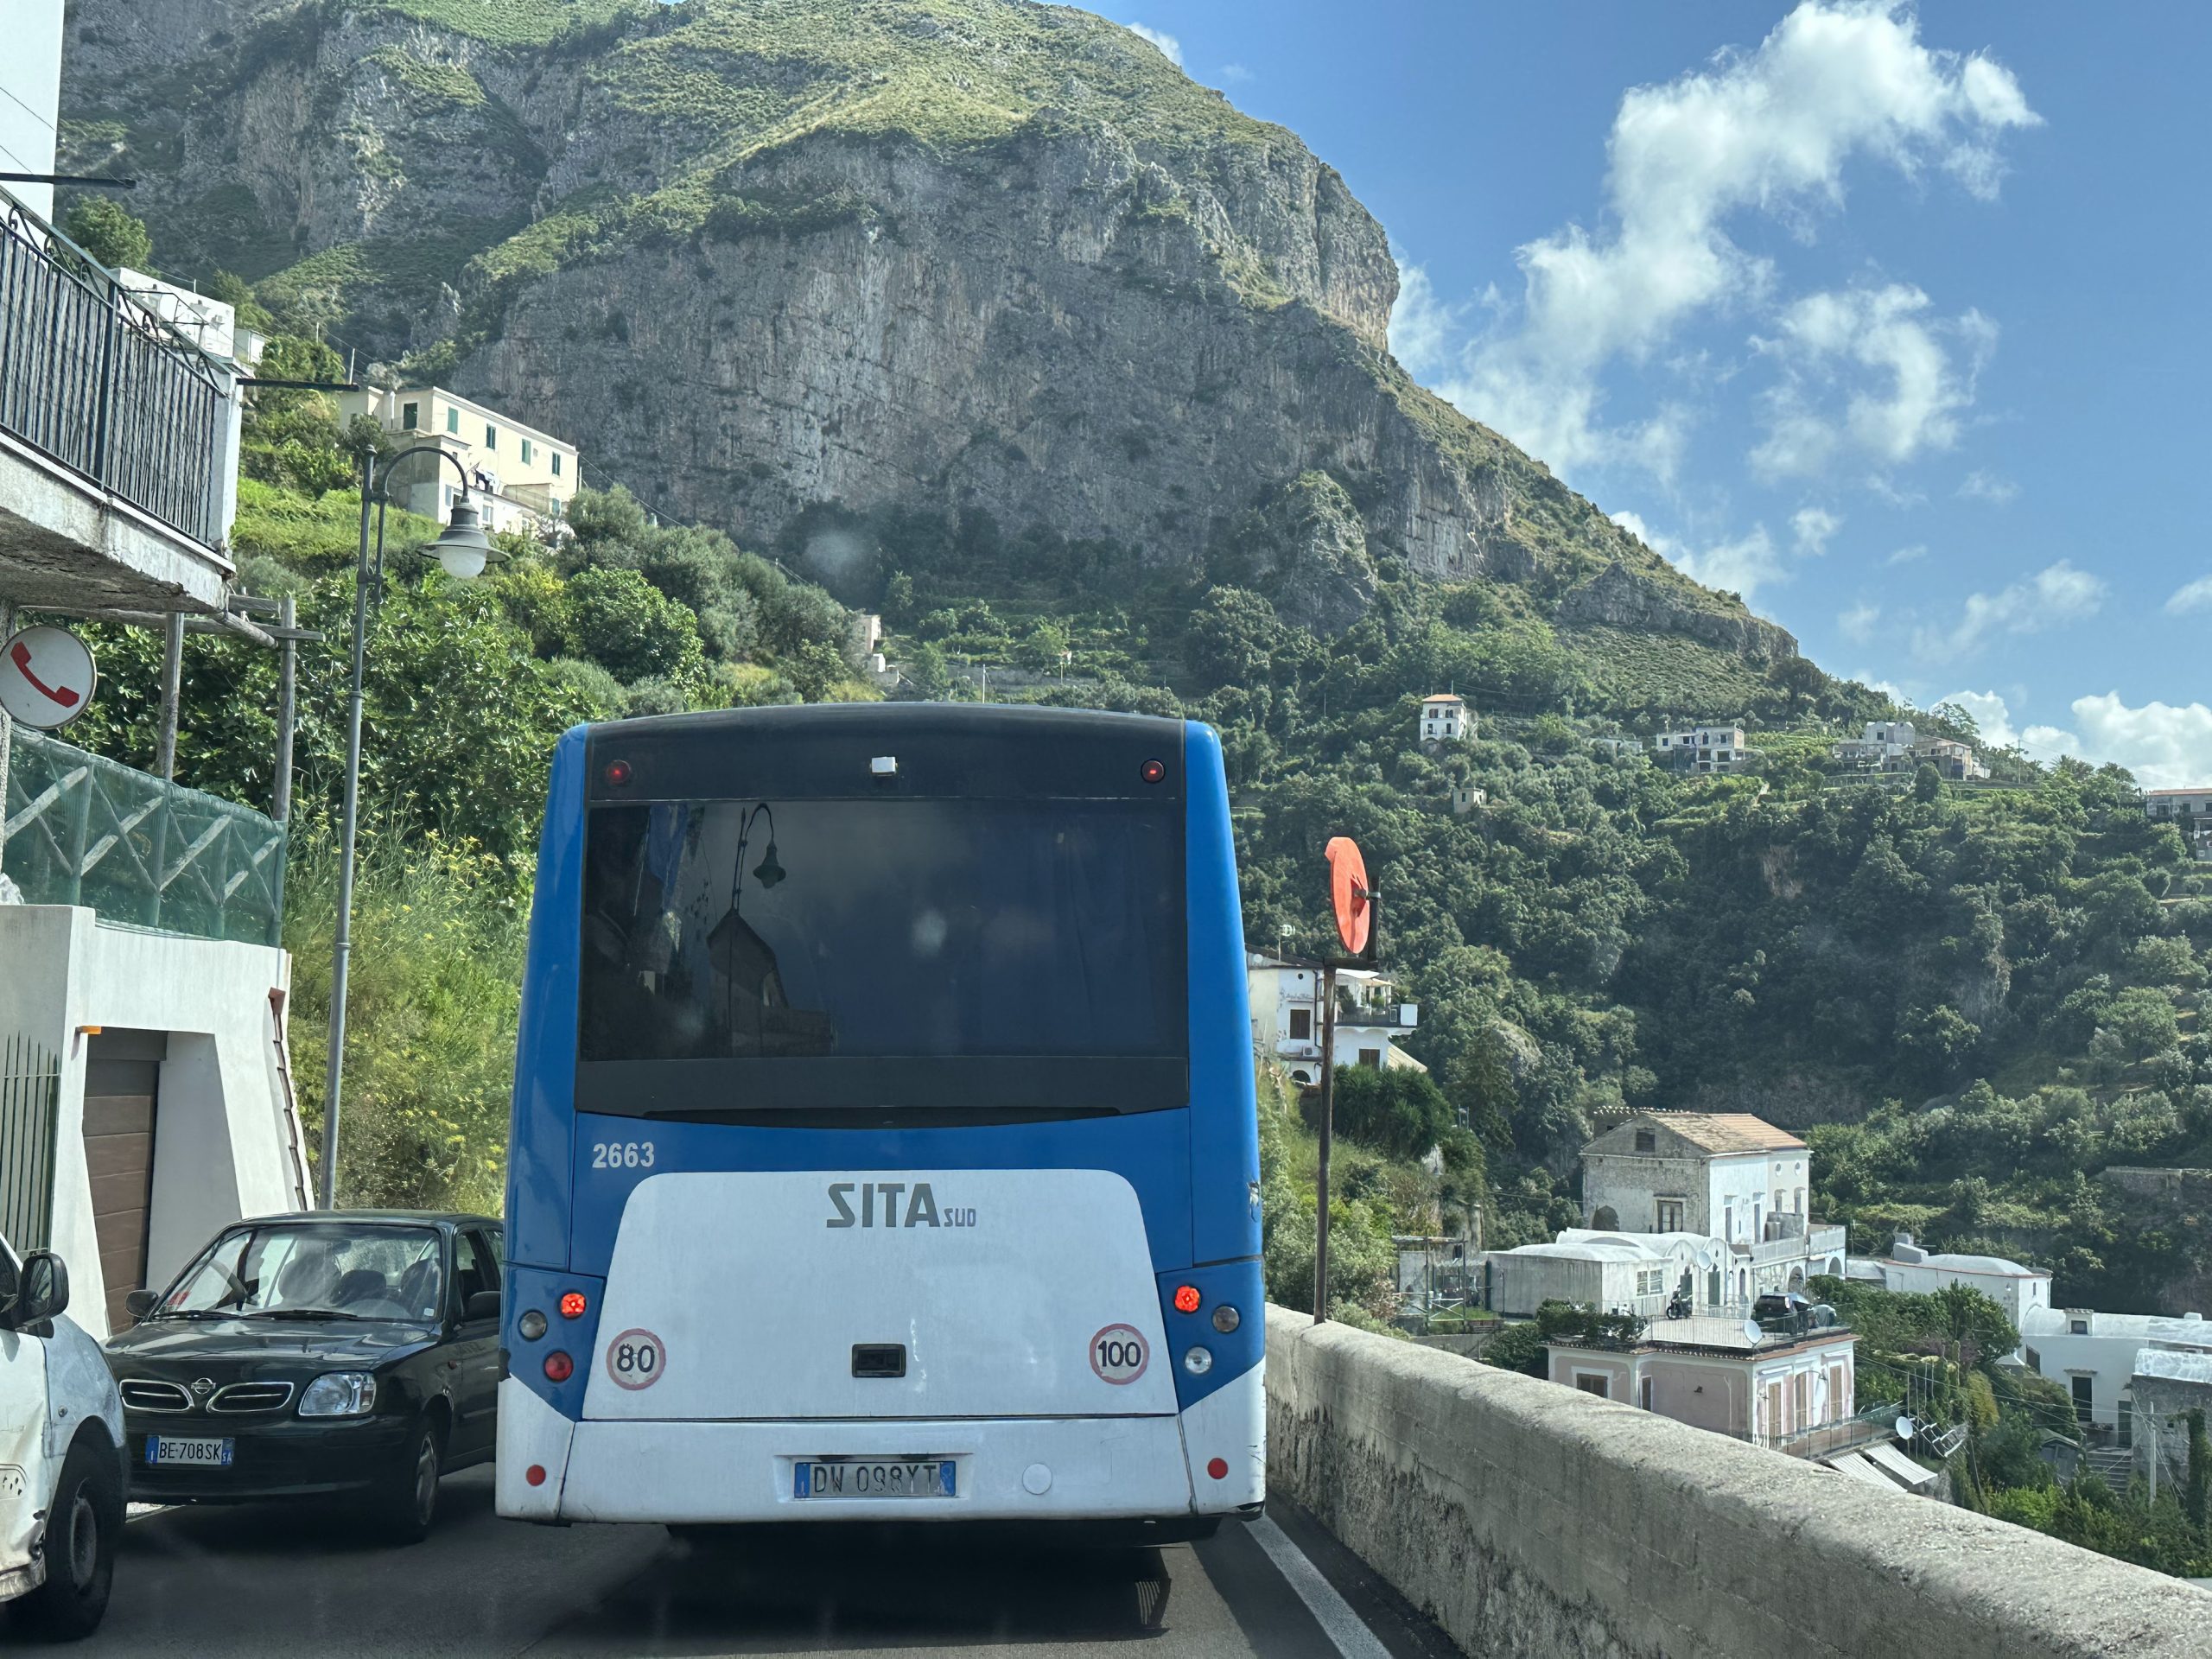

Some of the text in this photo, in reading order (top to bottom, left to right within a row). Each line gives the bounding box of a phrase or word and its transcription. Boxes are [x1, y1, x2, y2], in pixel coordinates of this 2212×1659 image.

[592, 1142, 655, 1168] 2663
[826, 1183, 976, 1229] SITA SUD
[616, 1343, 655, 1373] 80
[1097, 1340, 1141, 1367] 100
